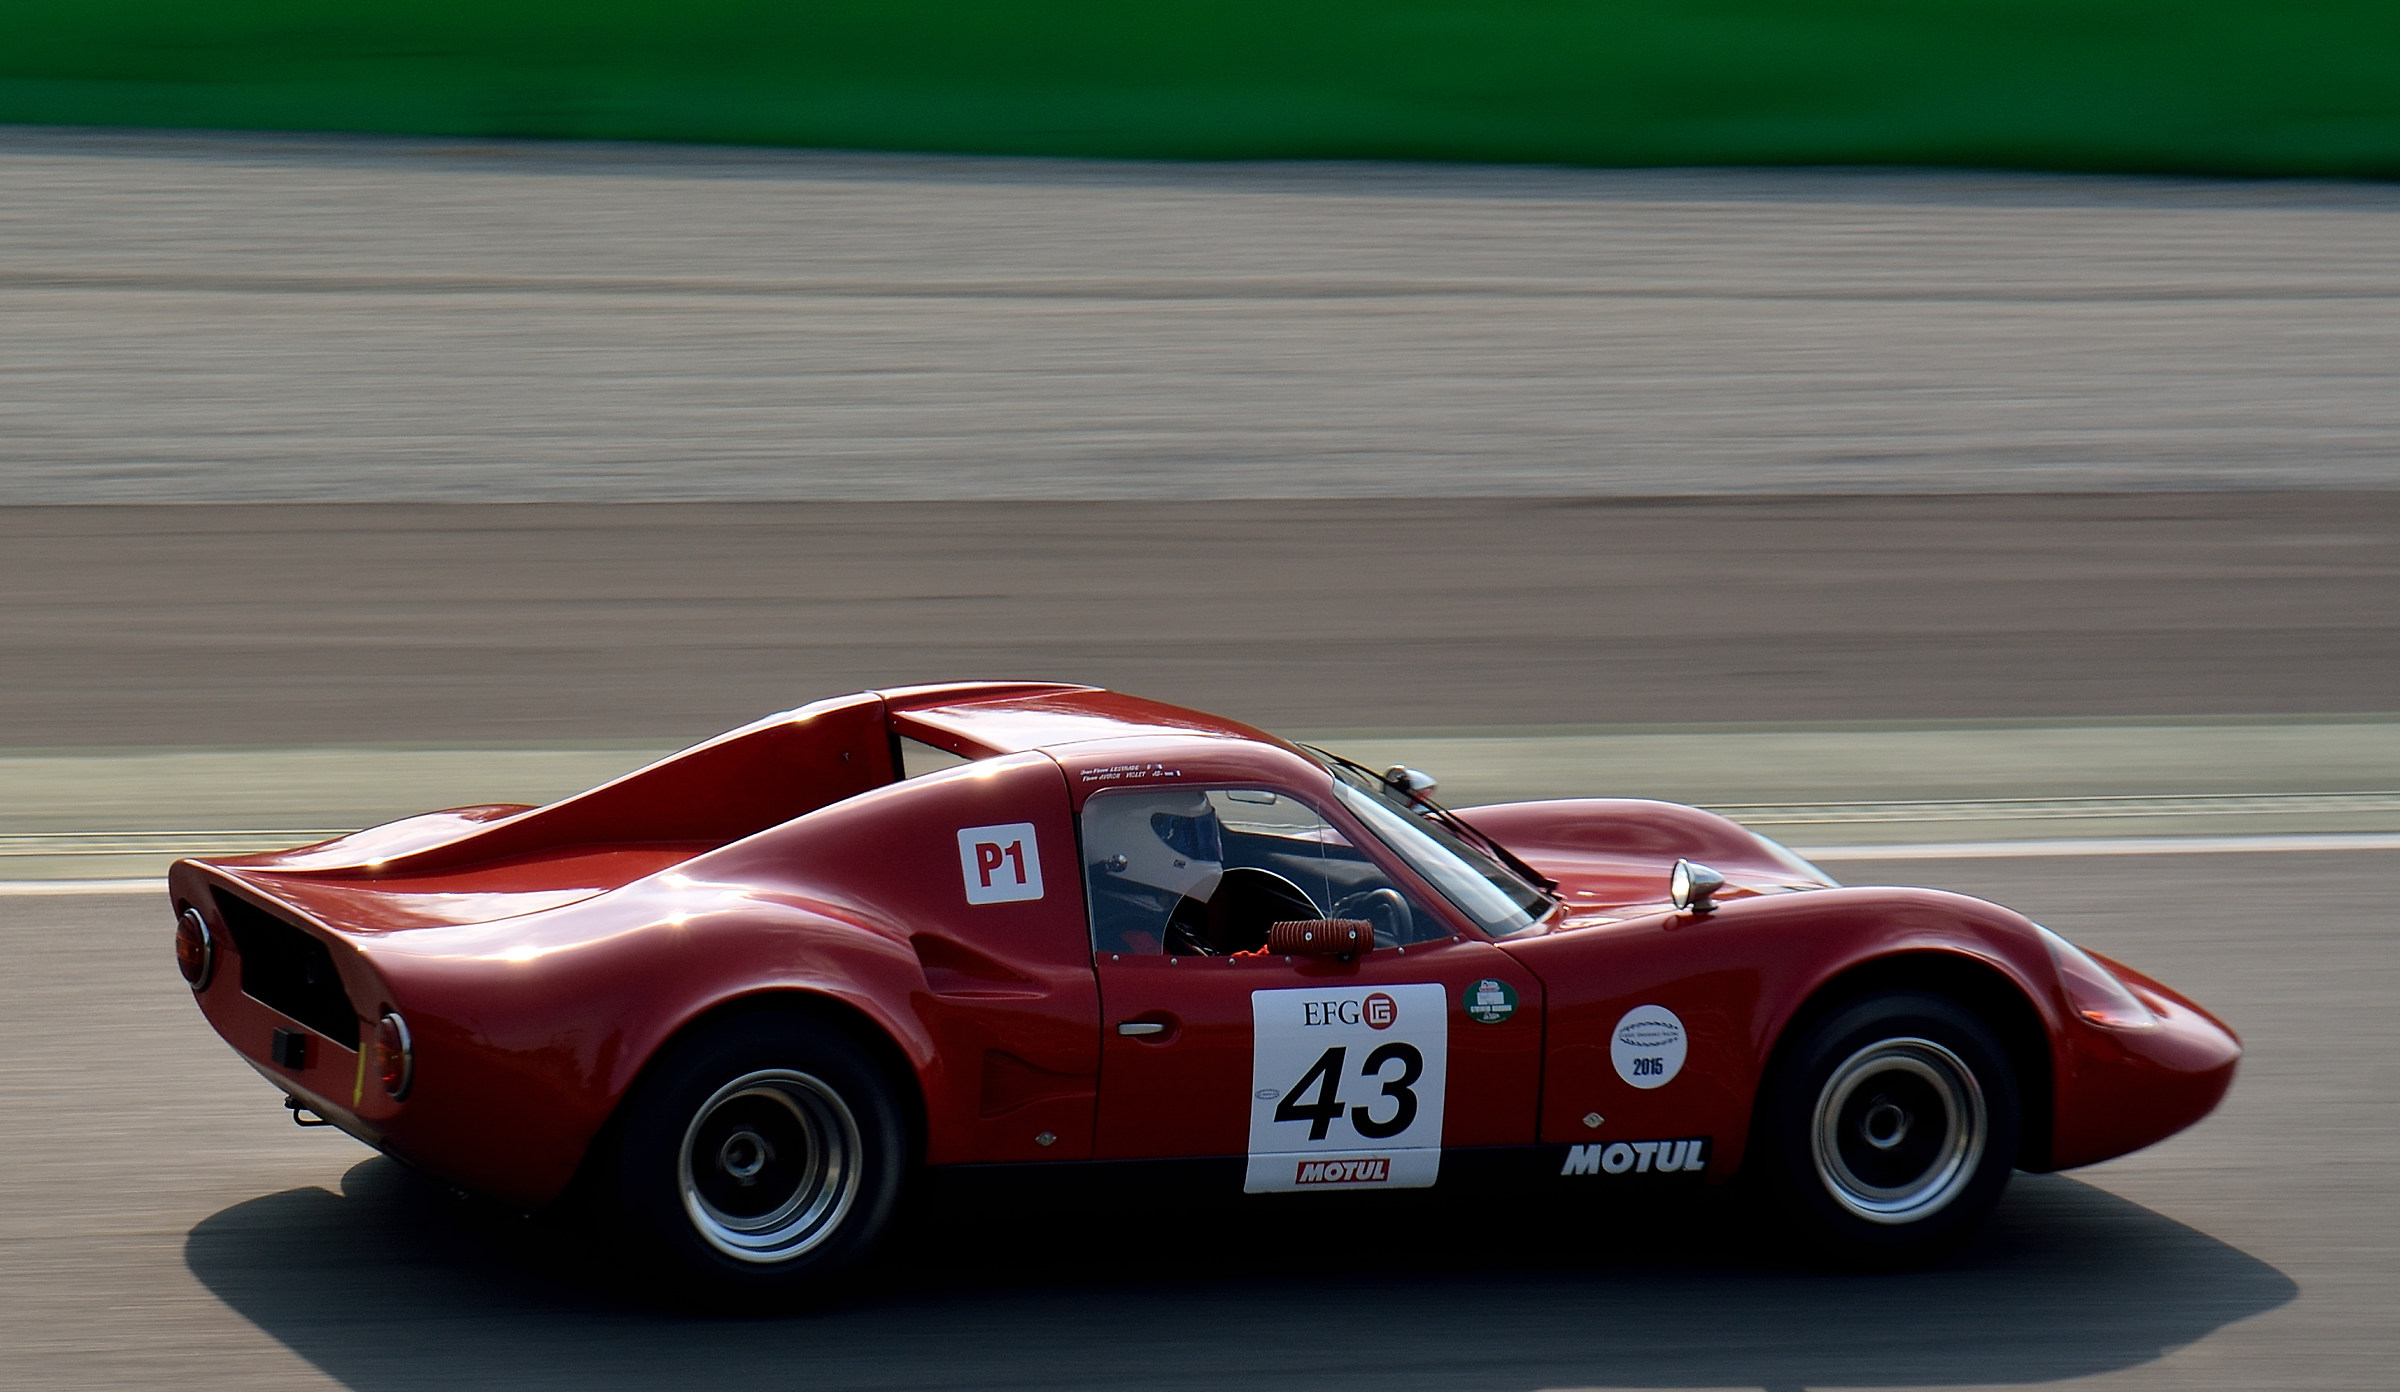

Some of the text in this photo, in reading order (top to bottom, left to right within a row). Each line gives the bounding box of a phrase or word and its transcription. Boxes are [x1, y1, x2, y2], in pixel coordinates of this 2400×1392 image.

[975, 840, 1027, 888] P1
[1302, 999, 1360, 1026] EFG
[1633, 1057, 1663, 1076] 2015
[1273, 1042, 1424, 1141] 43
[1298, 1161, 1386, 1183] MOTUL
[1560, 1140, 1705, 1176] MOTUL
